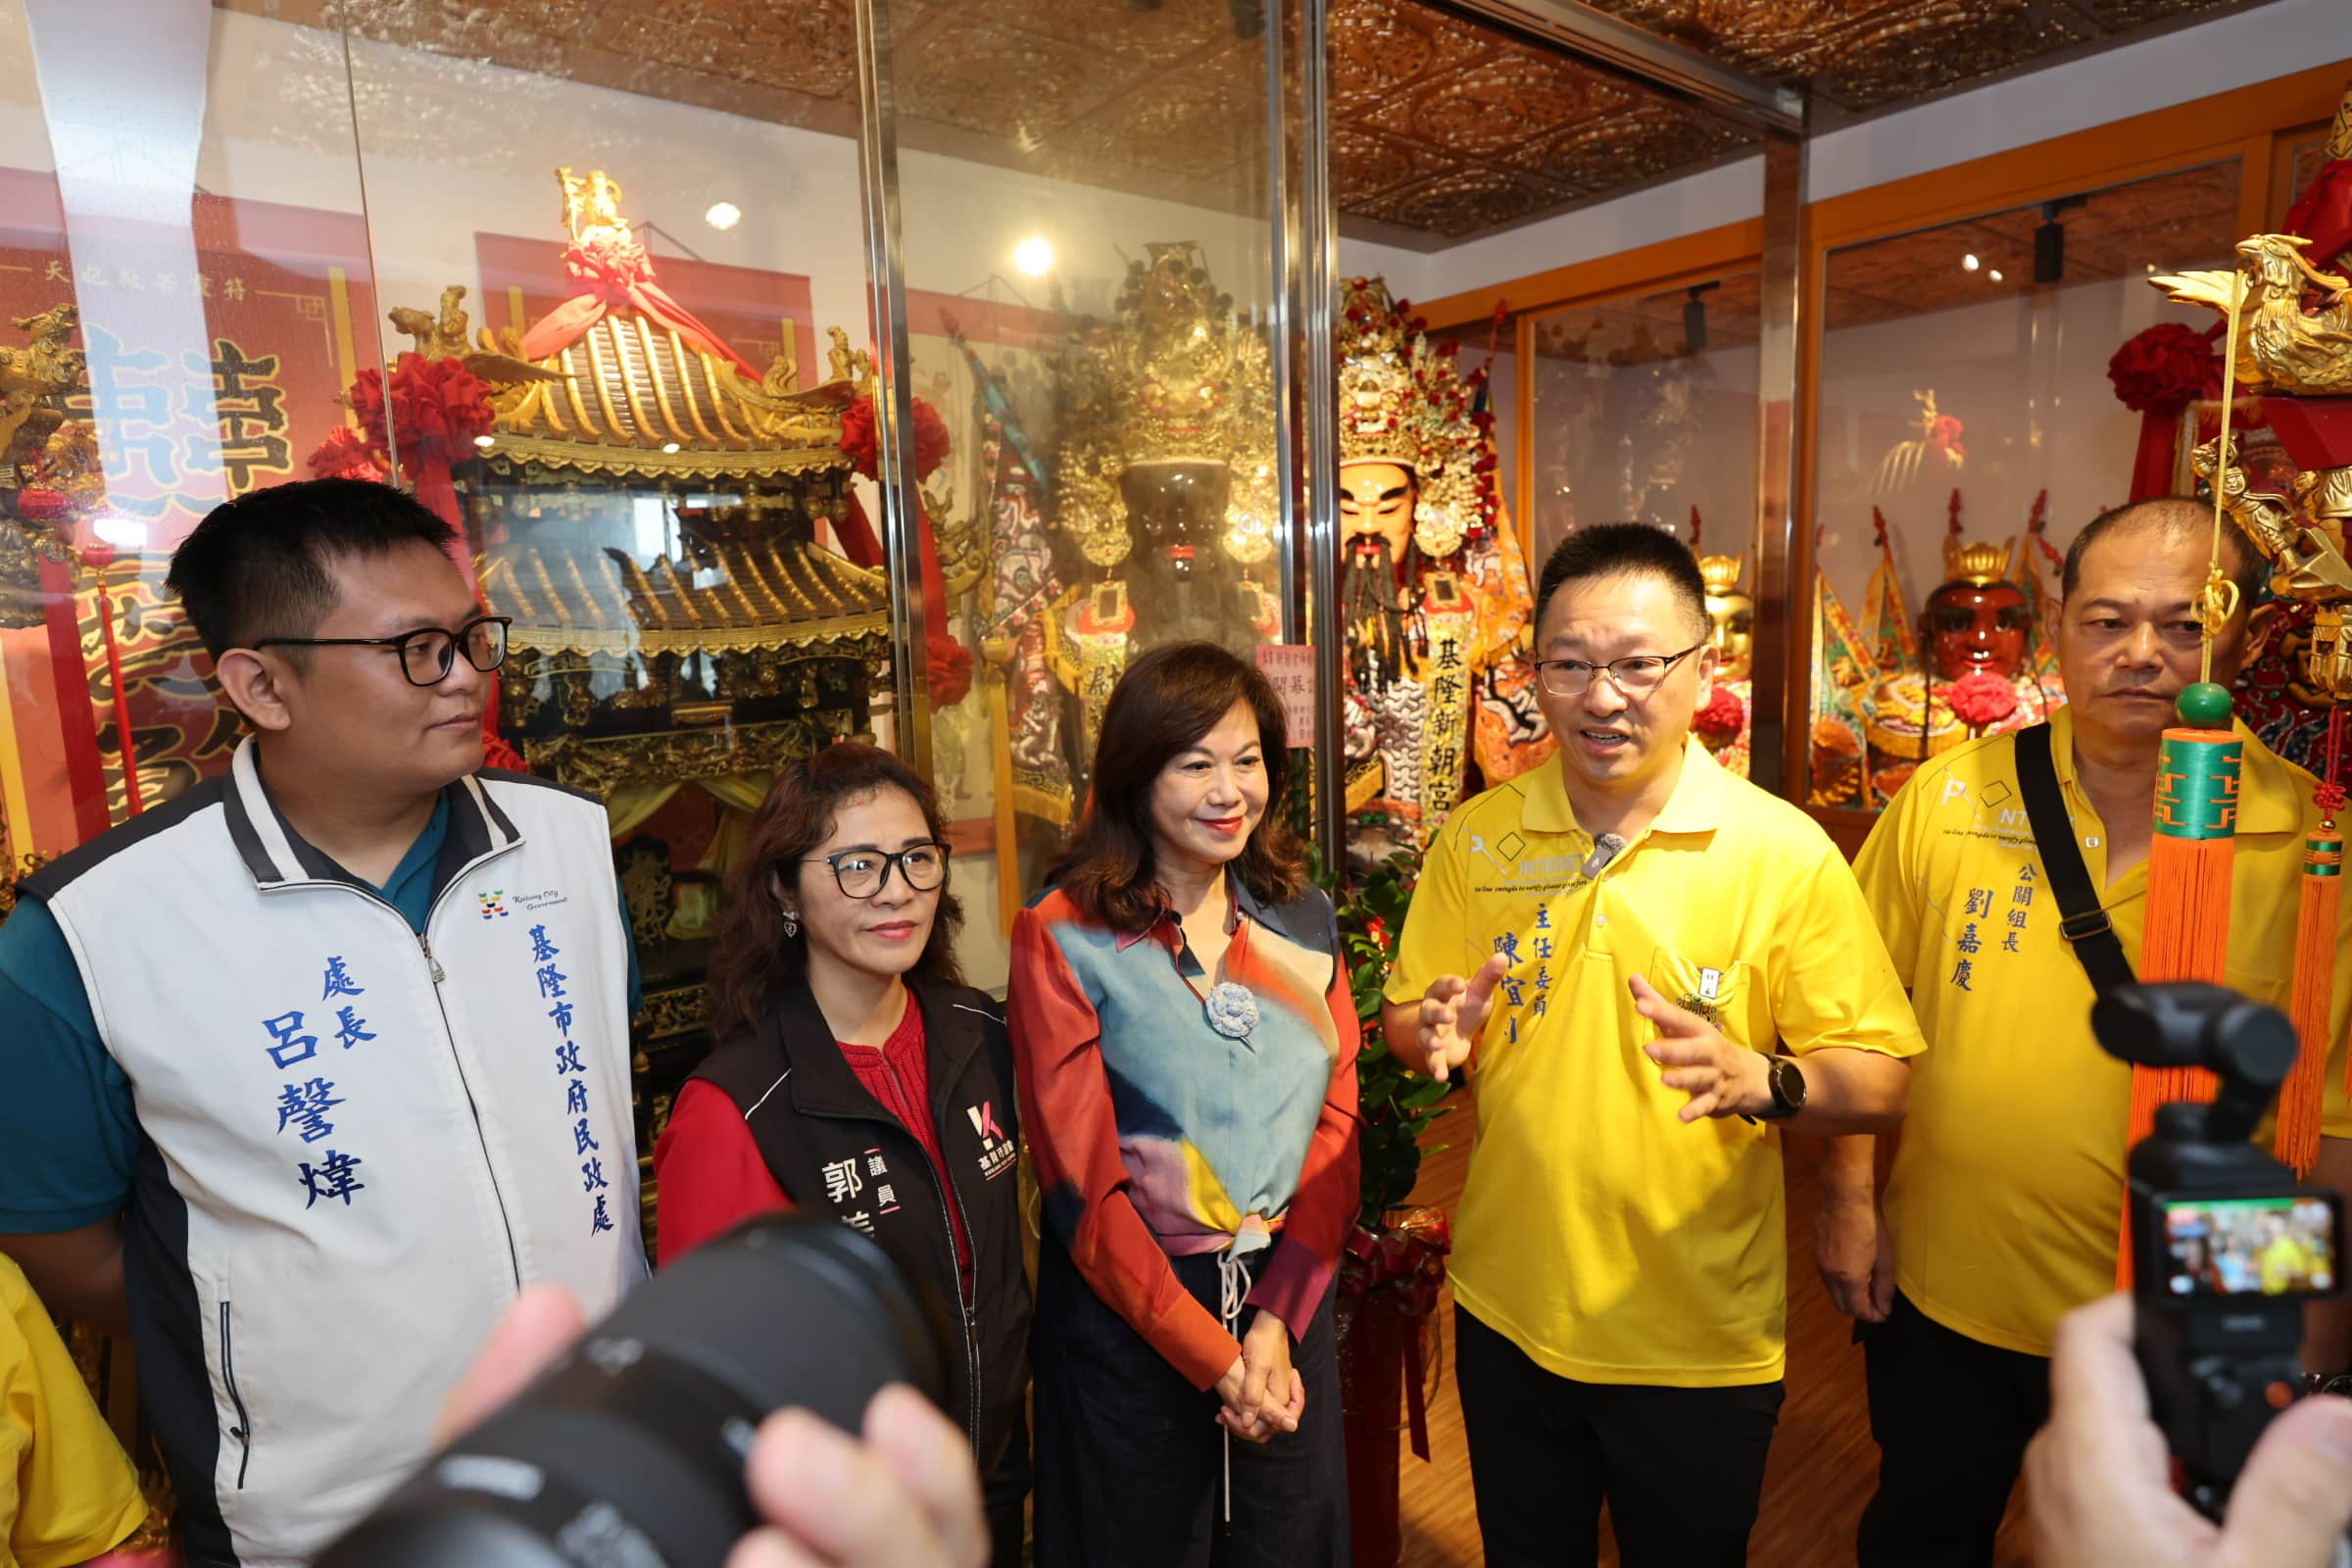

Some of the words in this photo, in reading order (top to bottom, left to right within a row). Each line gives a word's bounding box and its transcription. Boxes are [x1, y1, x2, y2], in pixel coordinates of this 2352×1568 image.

[1428, 638, 1462, 811] 基隆新朝宮
[543, 889, 559, 899] City
[1950, 887, 1994, 992] 劉嘉慶
[2002, 863, 2038, 953] 公關組長
[321, 956, 377, 1050] 處長
[1494, 931, 1526, 1044] 陳宜
[1532, 903, 1553, 1017] 主任委員
[527, 924, 614, 1238] 基隆市政府民政處
[867, 1155, 897, 1207] 議員
